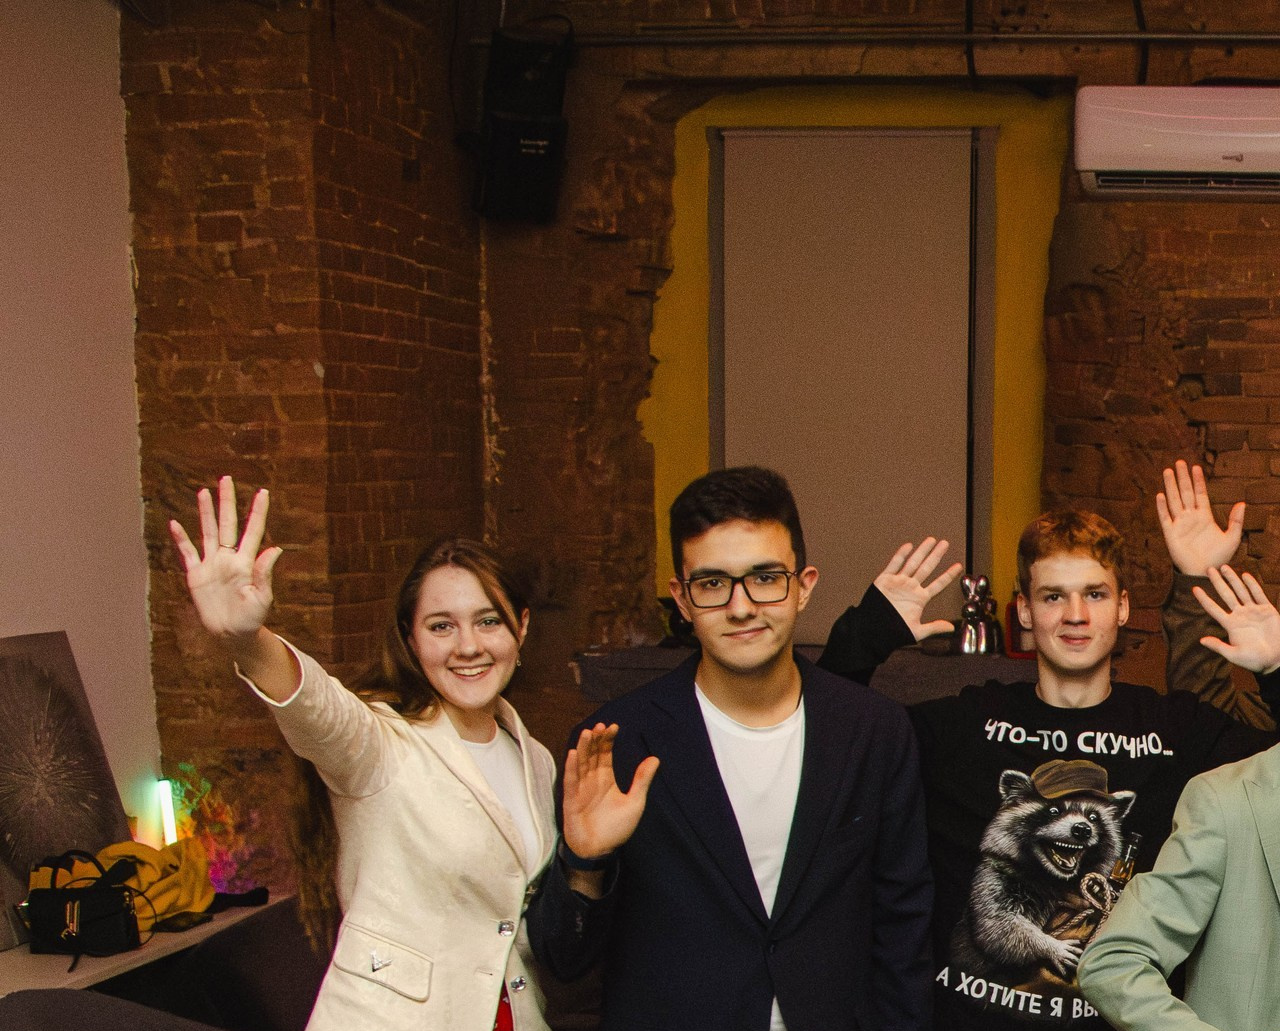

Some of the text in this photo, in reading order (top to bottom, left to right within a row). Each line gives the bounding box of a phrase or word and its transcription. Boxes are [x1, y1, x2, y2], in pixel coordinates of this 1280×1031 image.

[984, 718, 1068, 753] ЧТО-ТО
[935, 966, 1099, 1019] А ХОТИТЕ Я ВЫ
